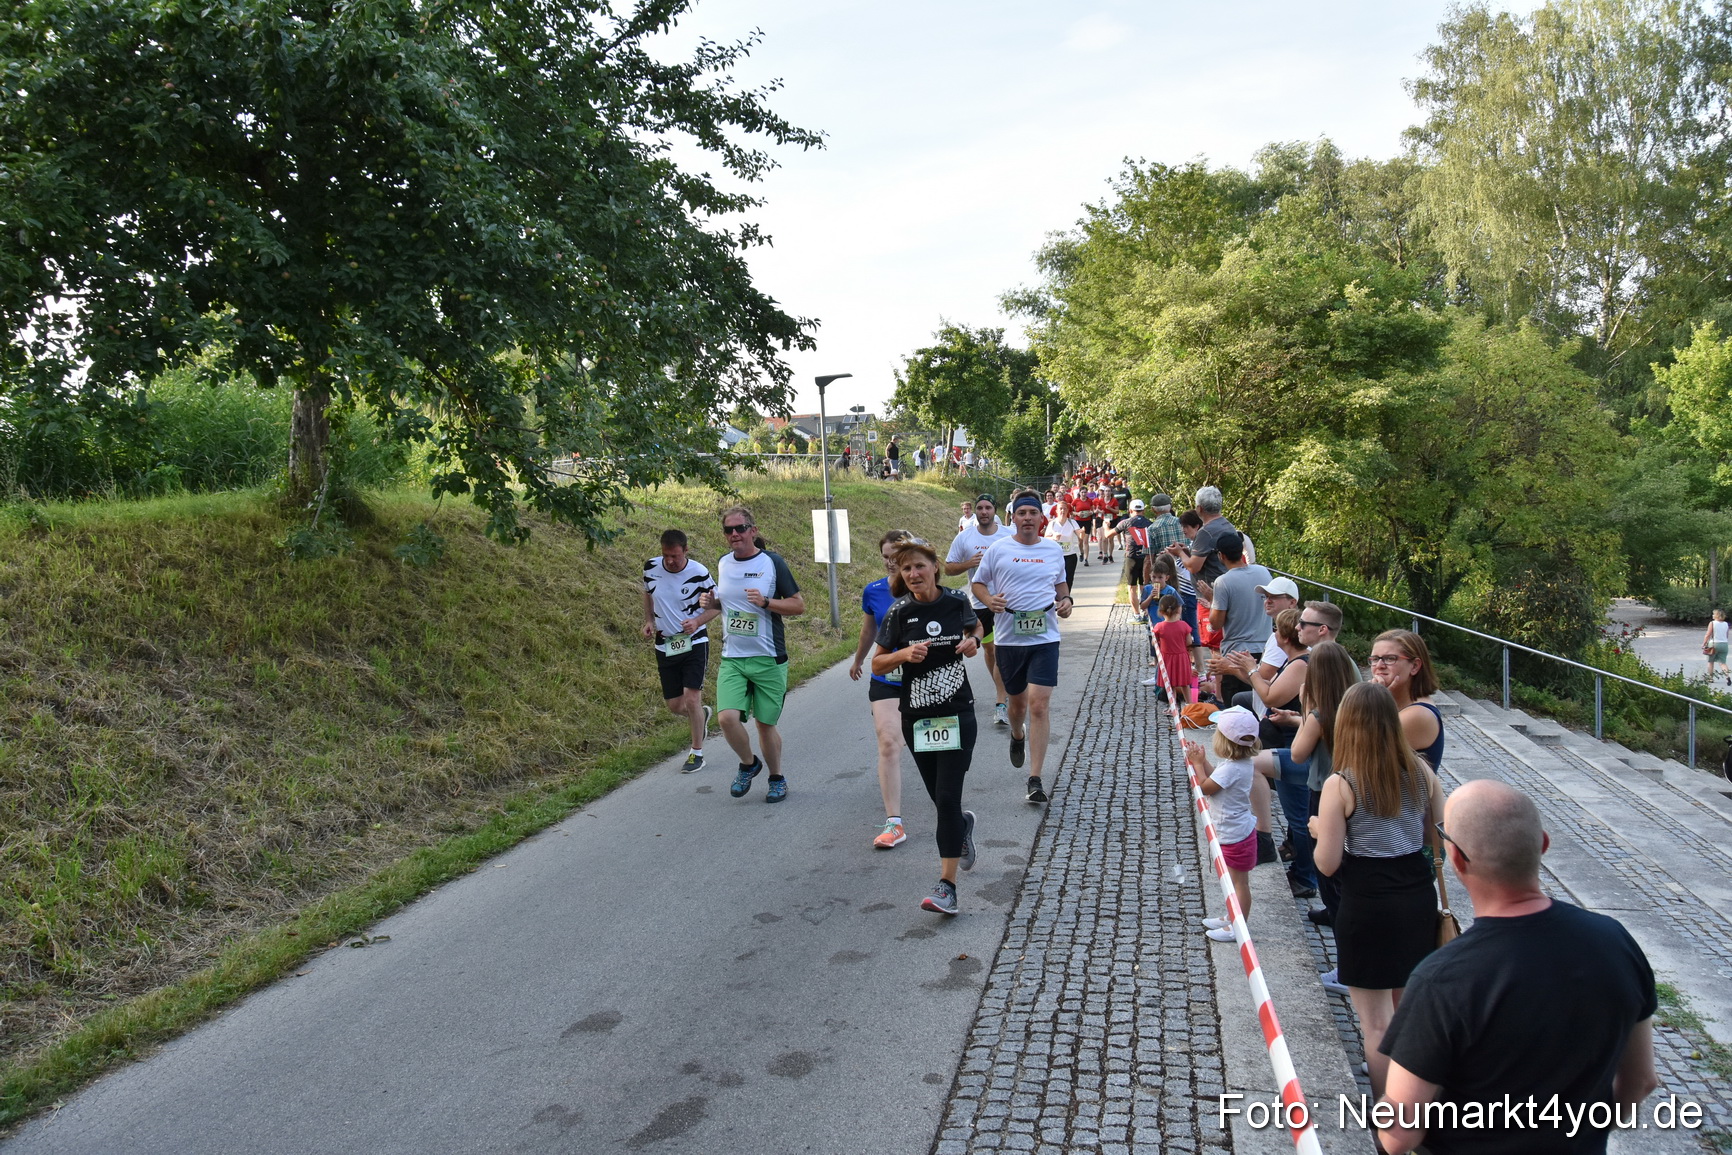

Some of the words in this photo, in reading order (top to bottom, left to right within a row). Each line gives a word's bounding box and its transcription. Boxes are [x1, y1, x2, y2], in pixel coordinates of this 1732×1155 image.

[730, 618, 754, 630] 2275
[1017, 618, 1043, 629] 1174
[670, 639, 686, 650] 802
[924, 729, 949, 742] 100
